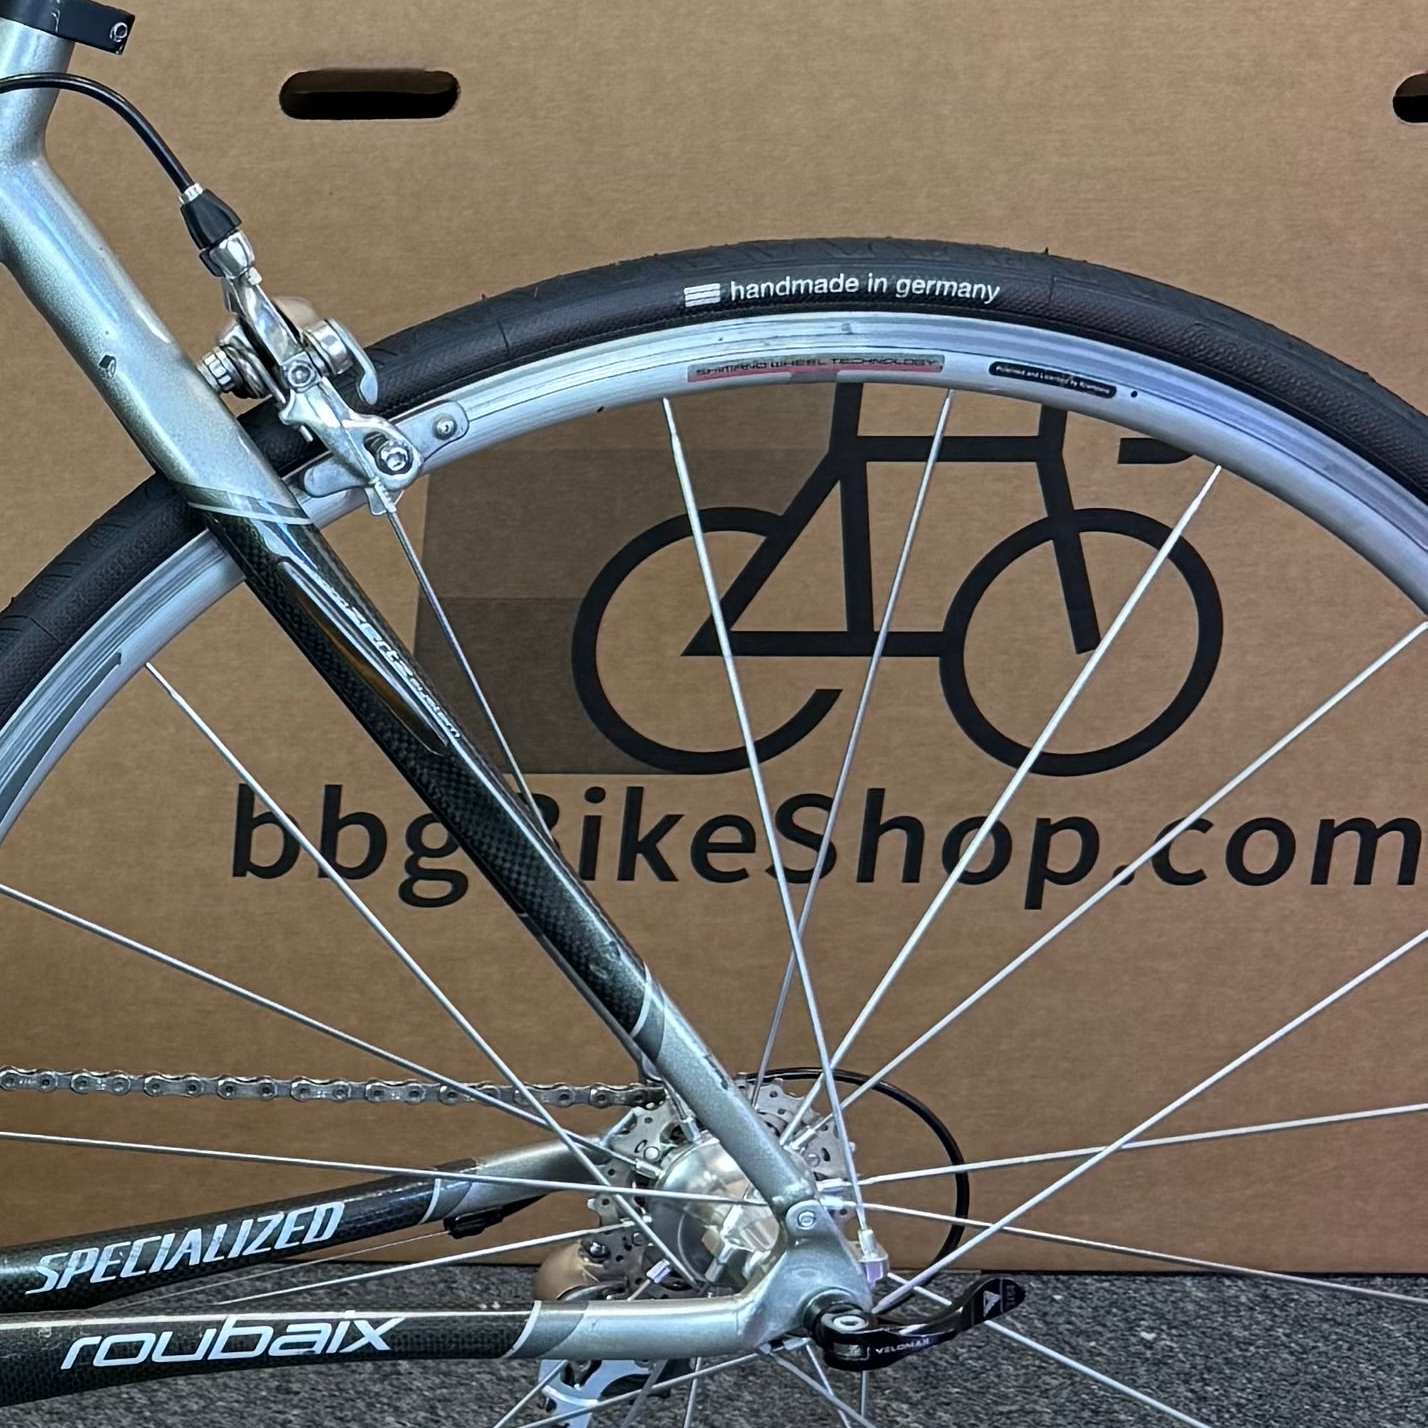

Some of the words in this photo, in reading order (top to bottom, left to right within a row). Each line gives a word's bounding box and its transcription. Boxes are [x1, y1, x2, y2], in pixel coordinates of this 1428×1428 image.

[730, 273, 859, 302] handmade
[868, 273, 888, 293] in
[895, 276, 1001, 305] germany
[25, 1202, 345, 1295] SPECIALIZED
[60, 1314, 405, 1370] roubaix
